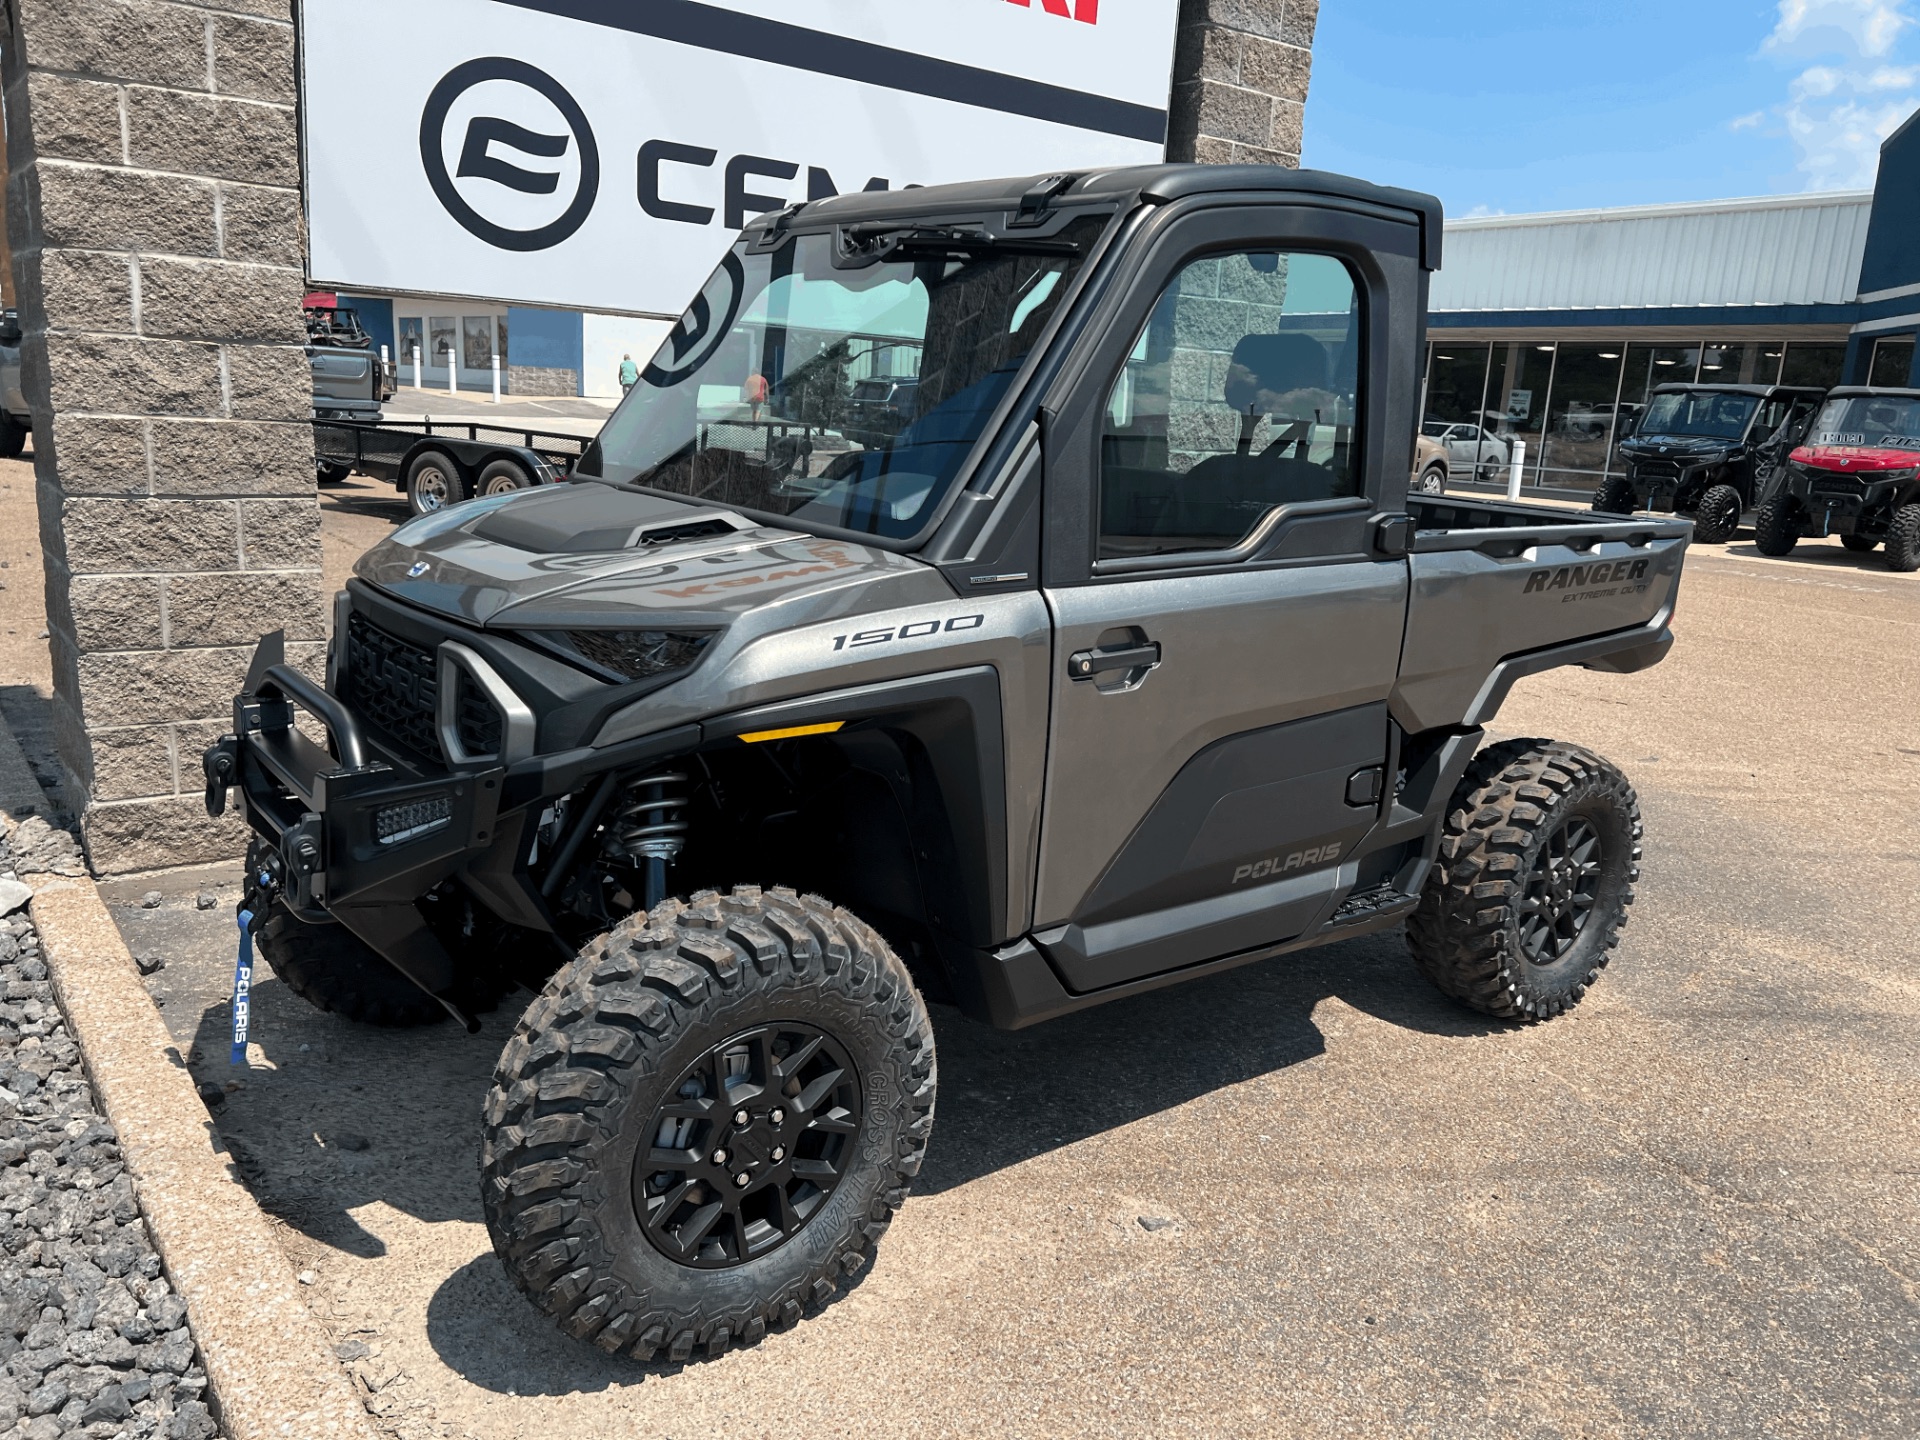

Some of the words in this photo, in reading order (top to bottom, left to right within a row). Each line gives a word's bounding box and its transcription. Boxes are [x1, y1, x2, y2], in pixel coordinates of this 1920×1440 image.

[1522, 559, 1649, 594] RANGER
[1561, 587, 1617, 603] EXTREME
[1620, 584, 1649, 595] DUTY
[833, 614, 984, 651] 1500
[1231, 841, 1342, 884] POLARIS
[234, 967, 251, 1044] POLARIS
[862, 1071, 890, 1166] CROSS
[802, 1174, 870, 1252] TRAIL
